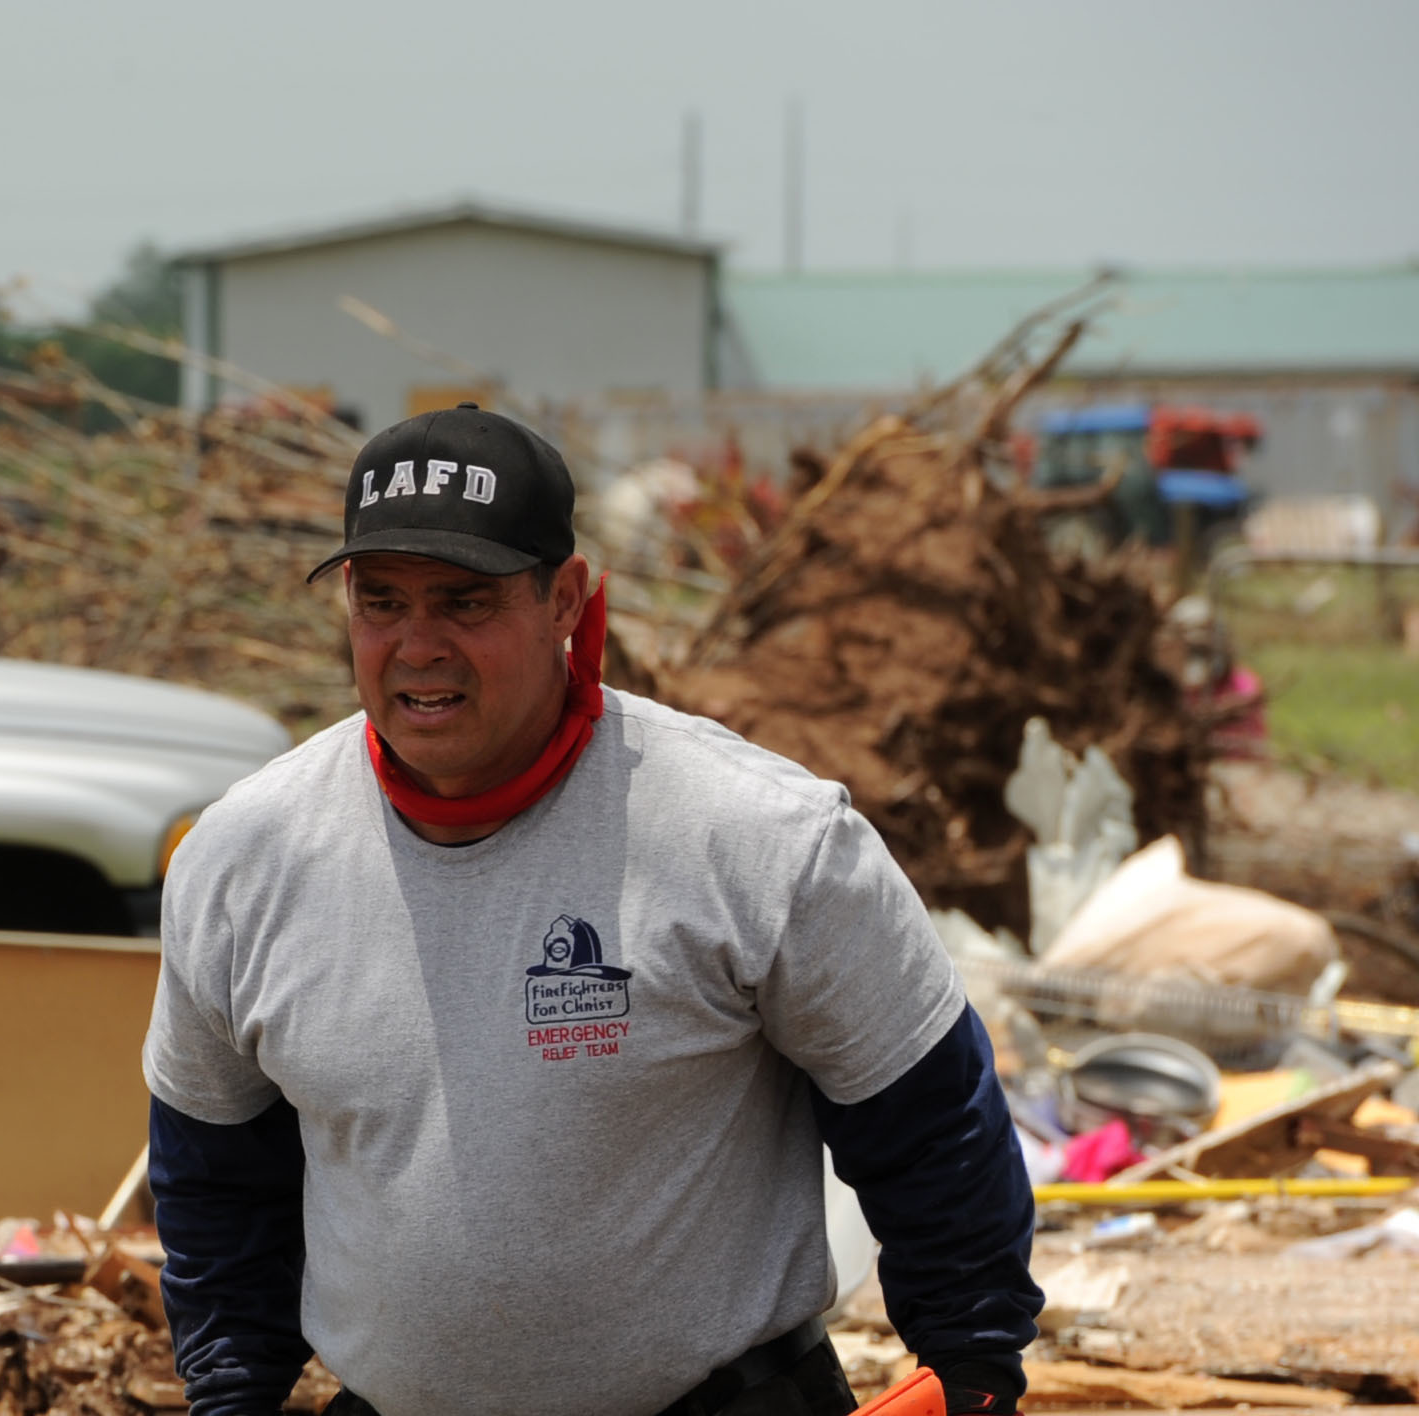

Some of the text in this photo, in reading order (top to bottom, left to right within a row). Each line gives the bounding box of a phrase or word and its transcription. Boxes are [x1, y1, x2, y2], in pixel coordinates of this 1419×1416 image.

[359, 459, 496, 509] LAFD
[528, 1022, 629, 1046] EMERGENCY
[542, 1043, 619, 1061] RELIEF TEAM
